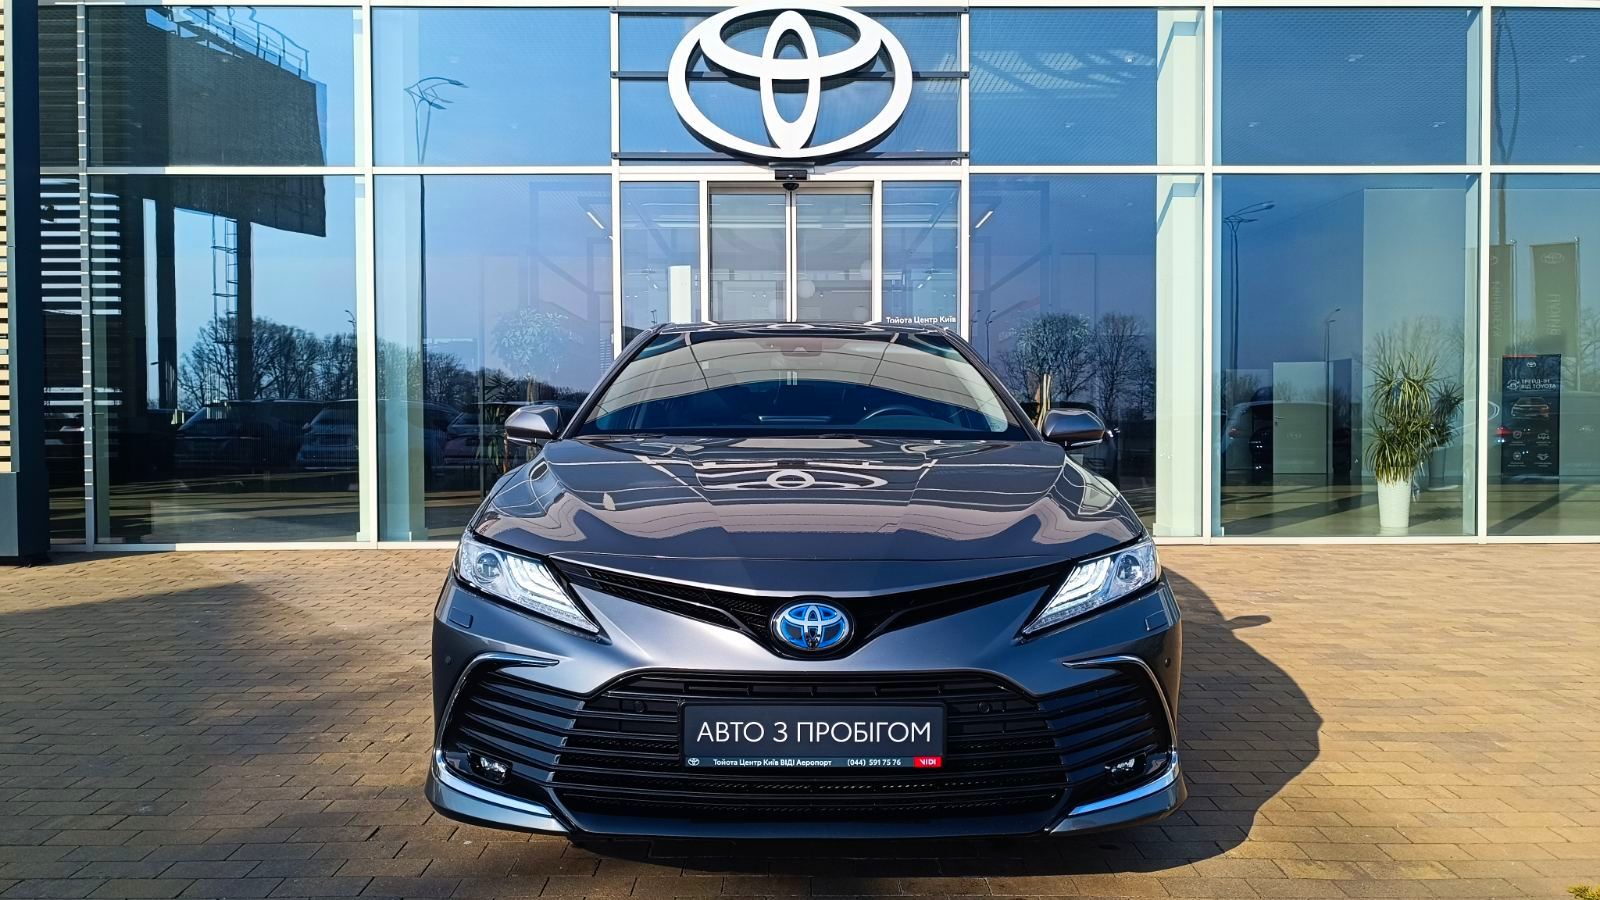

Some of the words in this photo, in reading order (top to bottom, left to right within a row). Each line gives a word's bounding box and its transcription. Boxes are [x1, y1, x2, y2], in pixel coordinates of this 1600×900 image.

[886, 316, 912, 324] Тойота
[913, 316, 938, 325] Центр
[939, 315, 956, 323] Київ
[696, 721, 765, 743] АВТО
[772, 721, 788, 743] З
[797, 721, 931, 743] ПРОБІГОМ
[713, 758, 738, 766] Тойота
[739, 758, 762, 767] Центр
[763, 758, 779, 766] Київ
[780, 758, 795, 767] ВІДІ
[796, 759, 832, 767] Аеропорт
[847, 758, 866, 767] (044)
[919, 758, 936, 766] VIDI
